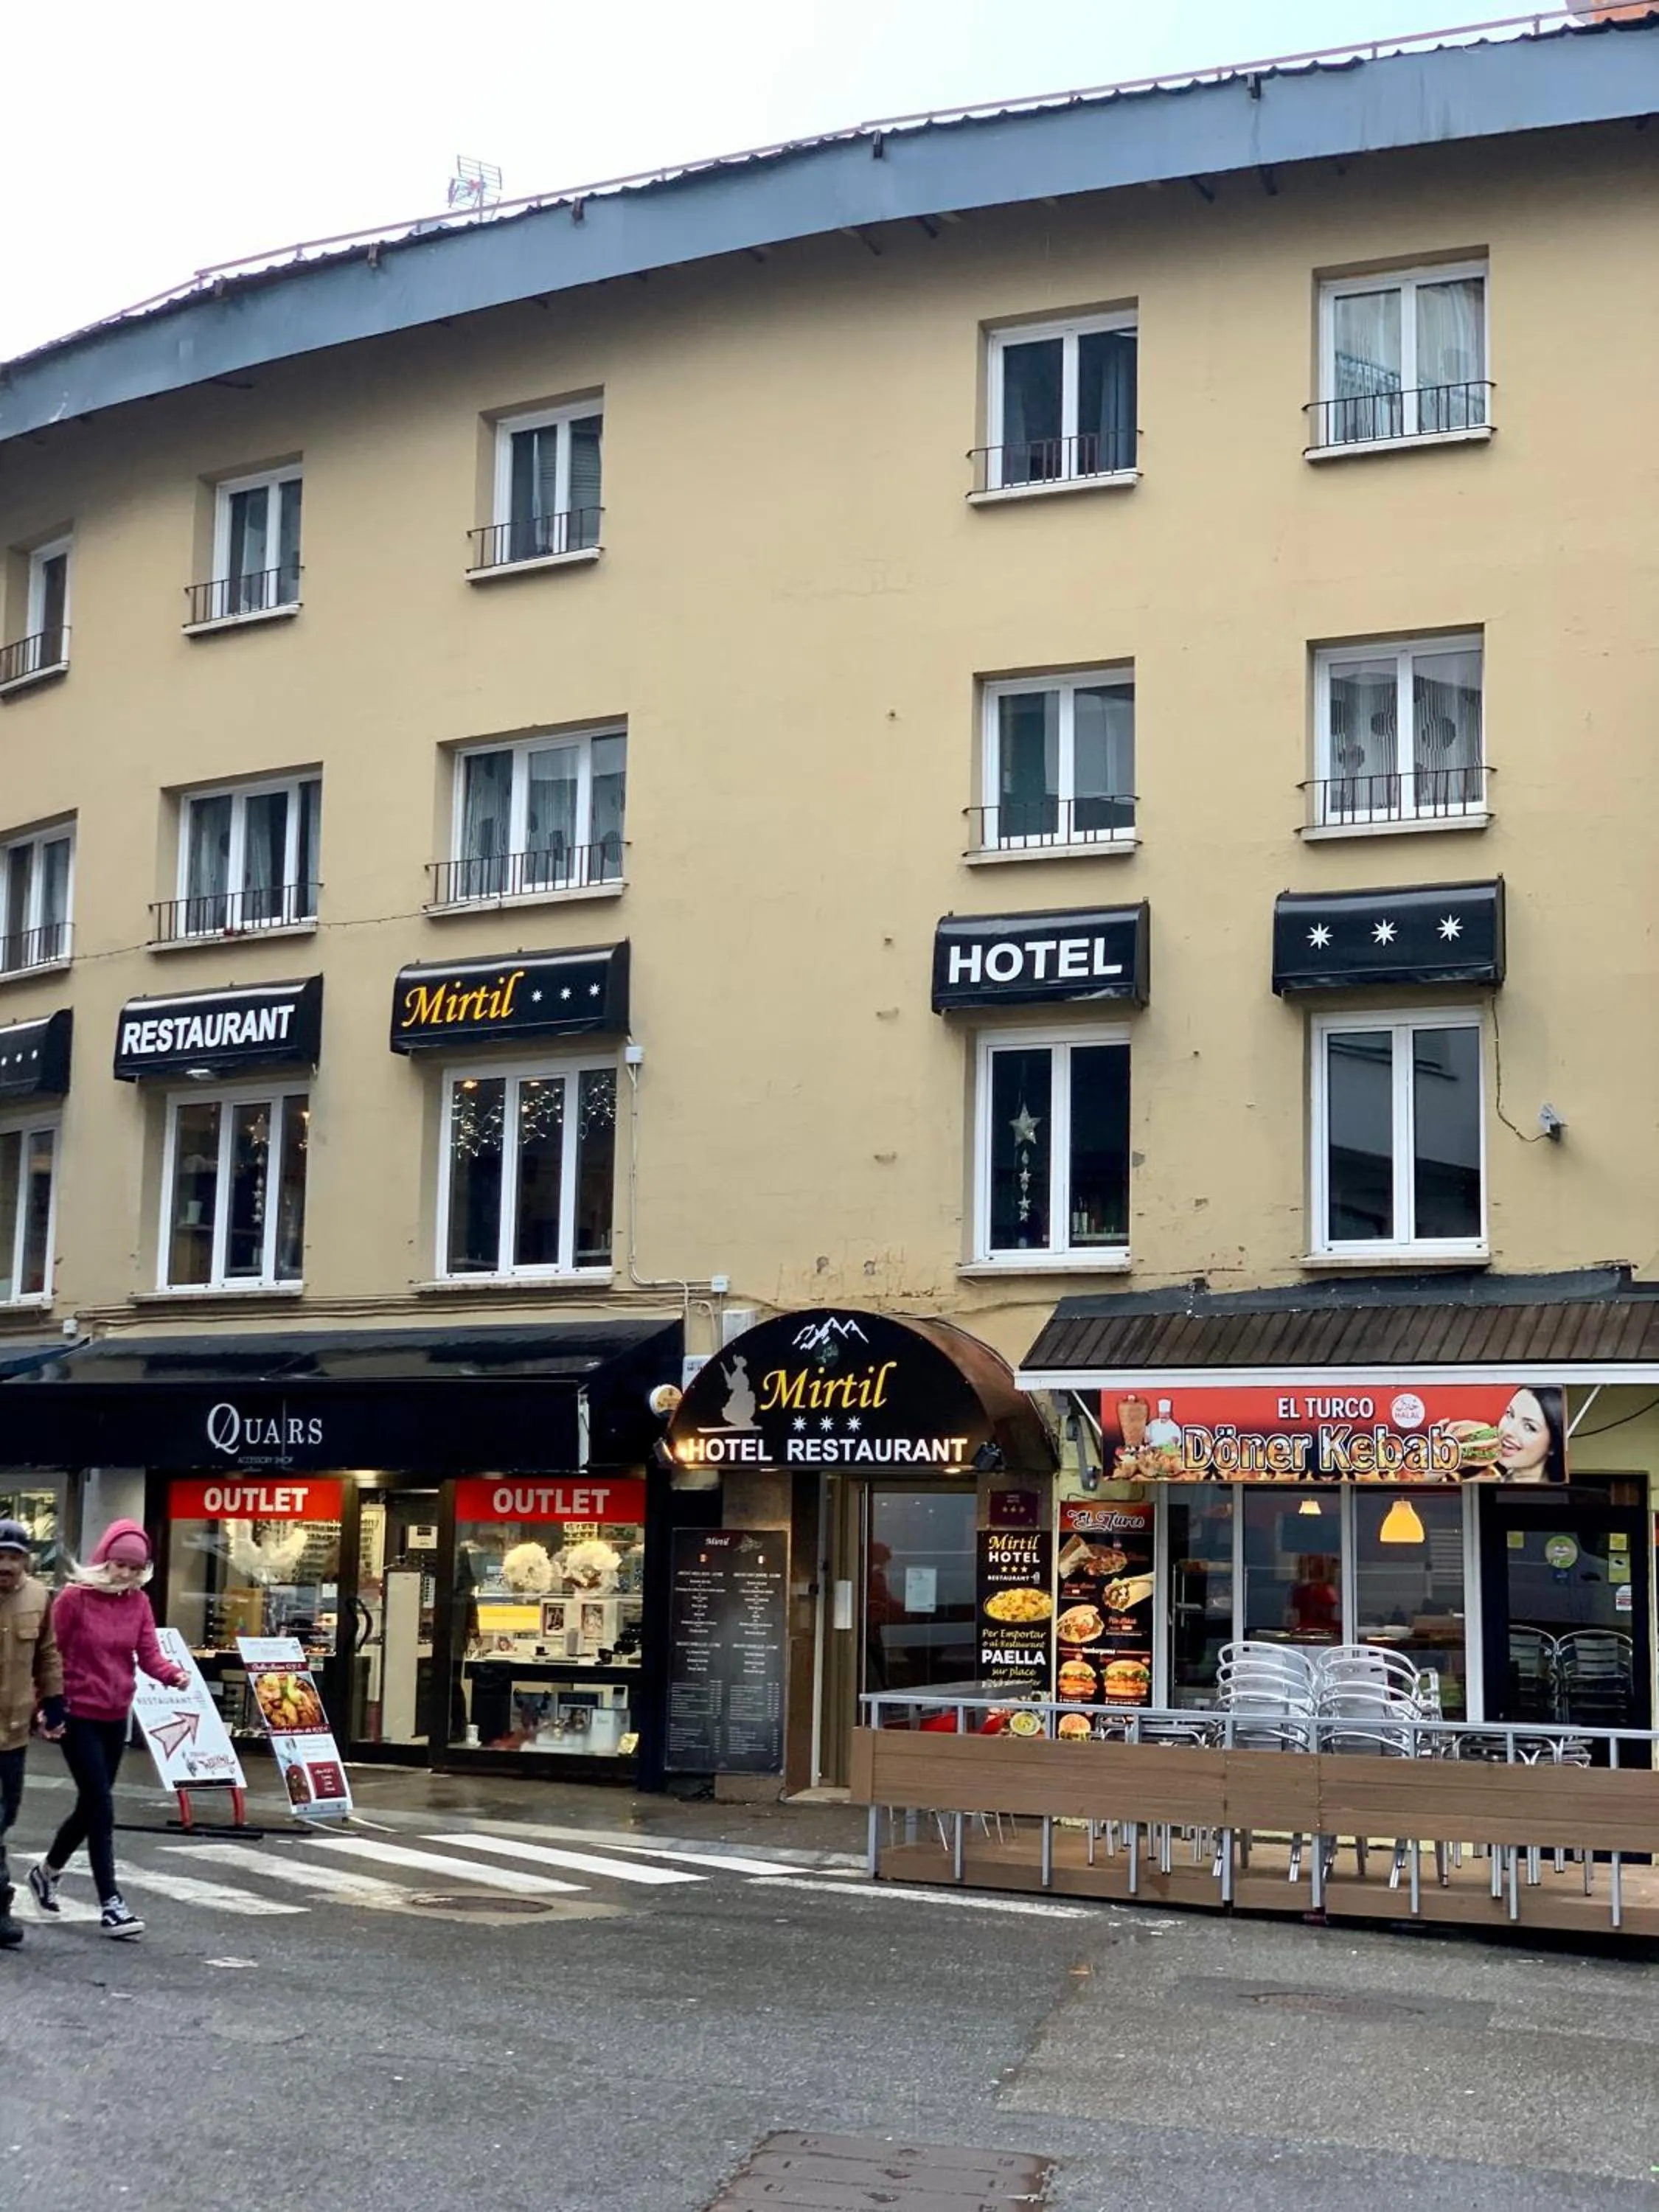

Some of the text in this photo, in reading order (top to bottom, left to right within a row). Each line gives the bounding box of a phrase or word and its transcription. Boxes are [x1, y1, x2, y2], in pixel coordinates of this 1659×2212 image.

[948, 936, 1123, 984] HOTEL
[401, 970, 526, 1028] Mirtil
[121, 1004, 295, 1056] RESTAURANT
[760, 1361, 898, 1411] Mirtil
[1278, 1397, 1374, 1419] EL TURCO
[1394, 1411, 1420, 1419] HALAL
[687, 1438, 967, 1463] HOTEL RESTAURANT
[1183, 1424, 1462, 1472] Döner Kebab
[204, 1487, 309, 1512] OUTLET
[493, 1488, 611, 1514] OUTLET
[988, 1534, 1041, 1550] Mirtil
[988, 1551, 1040, 1563] HOTEL
[981, 1649, 1046, 1665] PAELLA
